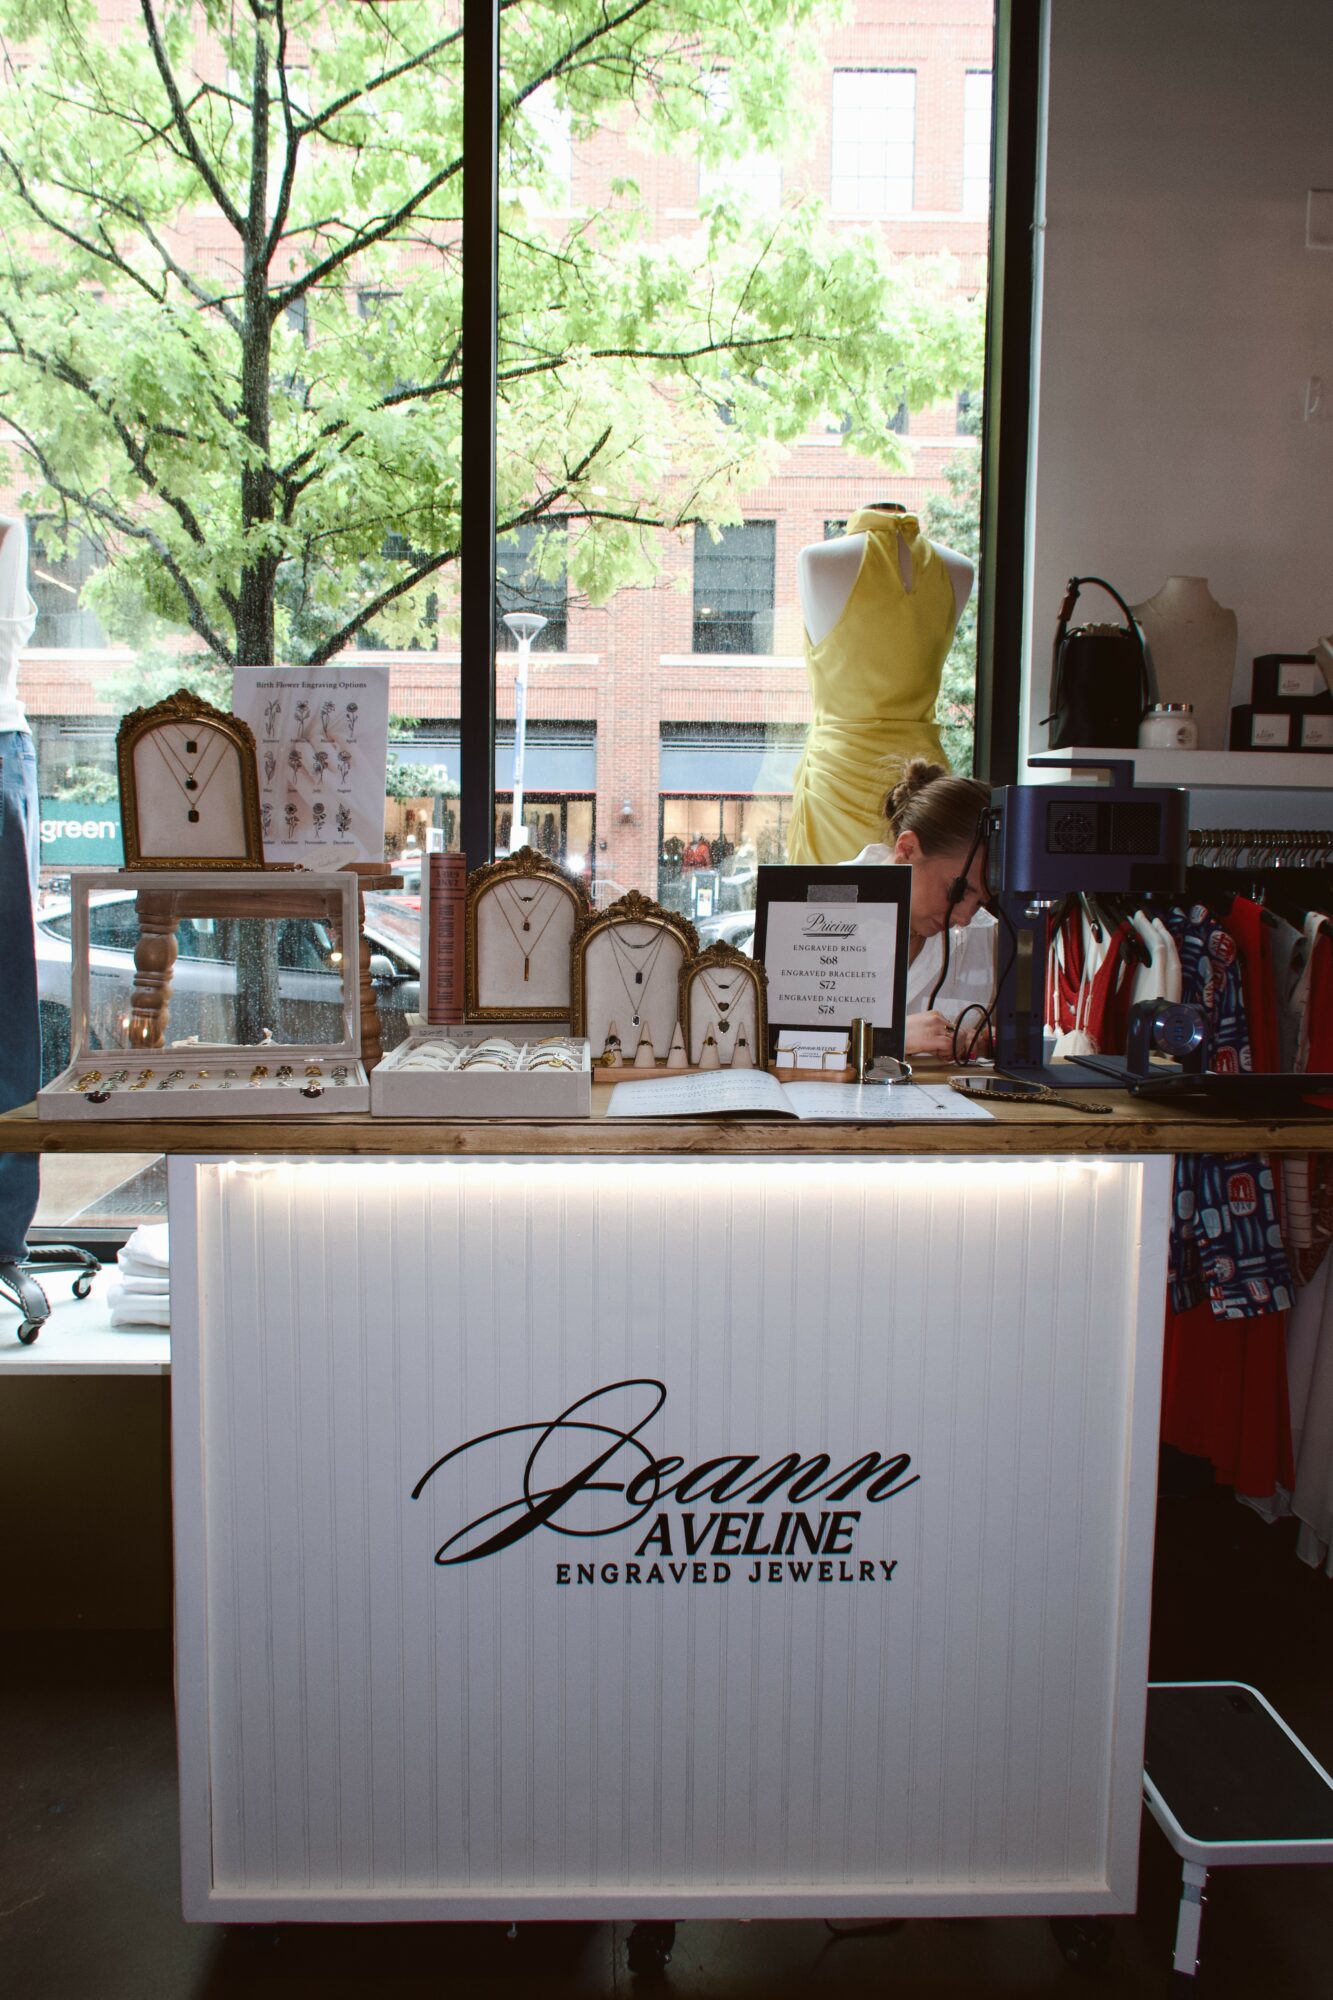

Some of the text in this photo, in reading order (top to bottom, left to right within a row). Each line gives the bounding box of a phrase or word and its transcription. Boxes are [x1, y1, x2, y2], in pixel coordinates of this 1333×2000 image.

[256, 681, 367, 691] Birth Flower Engraving Options
[40, 819, 116, 843] green
[437, 904, 455, 938] CANYON
[801, 912, 859, 939] Pricing
[437, 940, 454, 954] THE
[793, 944, 867, 953] ENGRAVED RINGS
[437, 970, 454, 988] CALL
[781, 969, 877, 979] ENGRAVED BRACELETS
[437, 991, 454, 1004] THE
[778, 994, 876, 1004] ENGRAVED NECKLACES
[410, 1378, 921, 1566] Jeann
[634, 1510, 862, 1557] AVELINE
[555, 1559, 900, 1585] ENGRAVED JEWELRY
